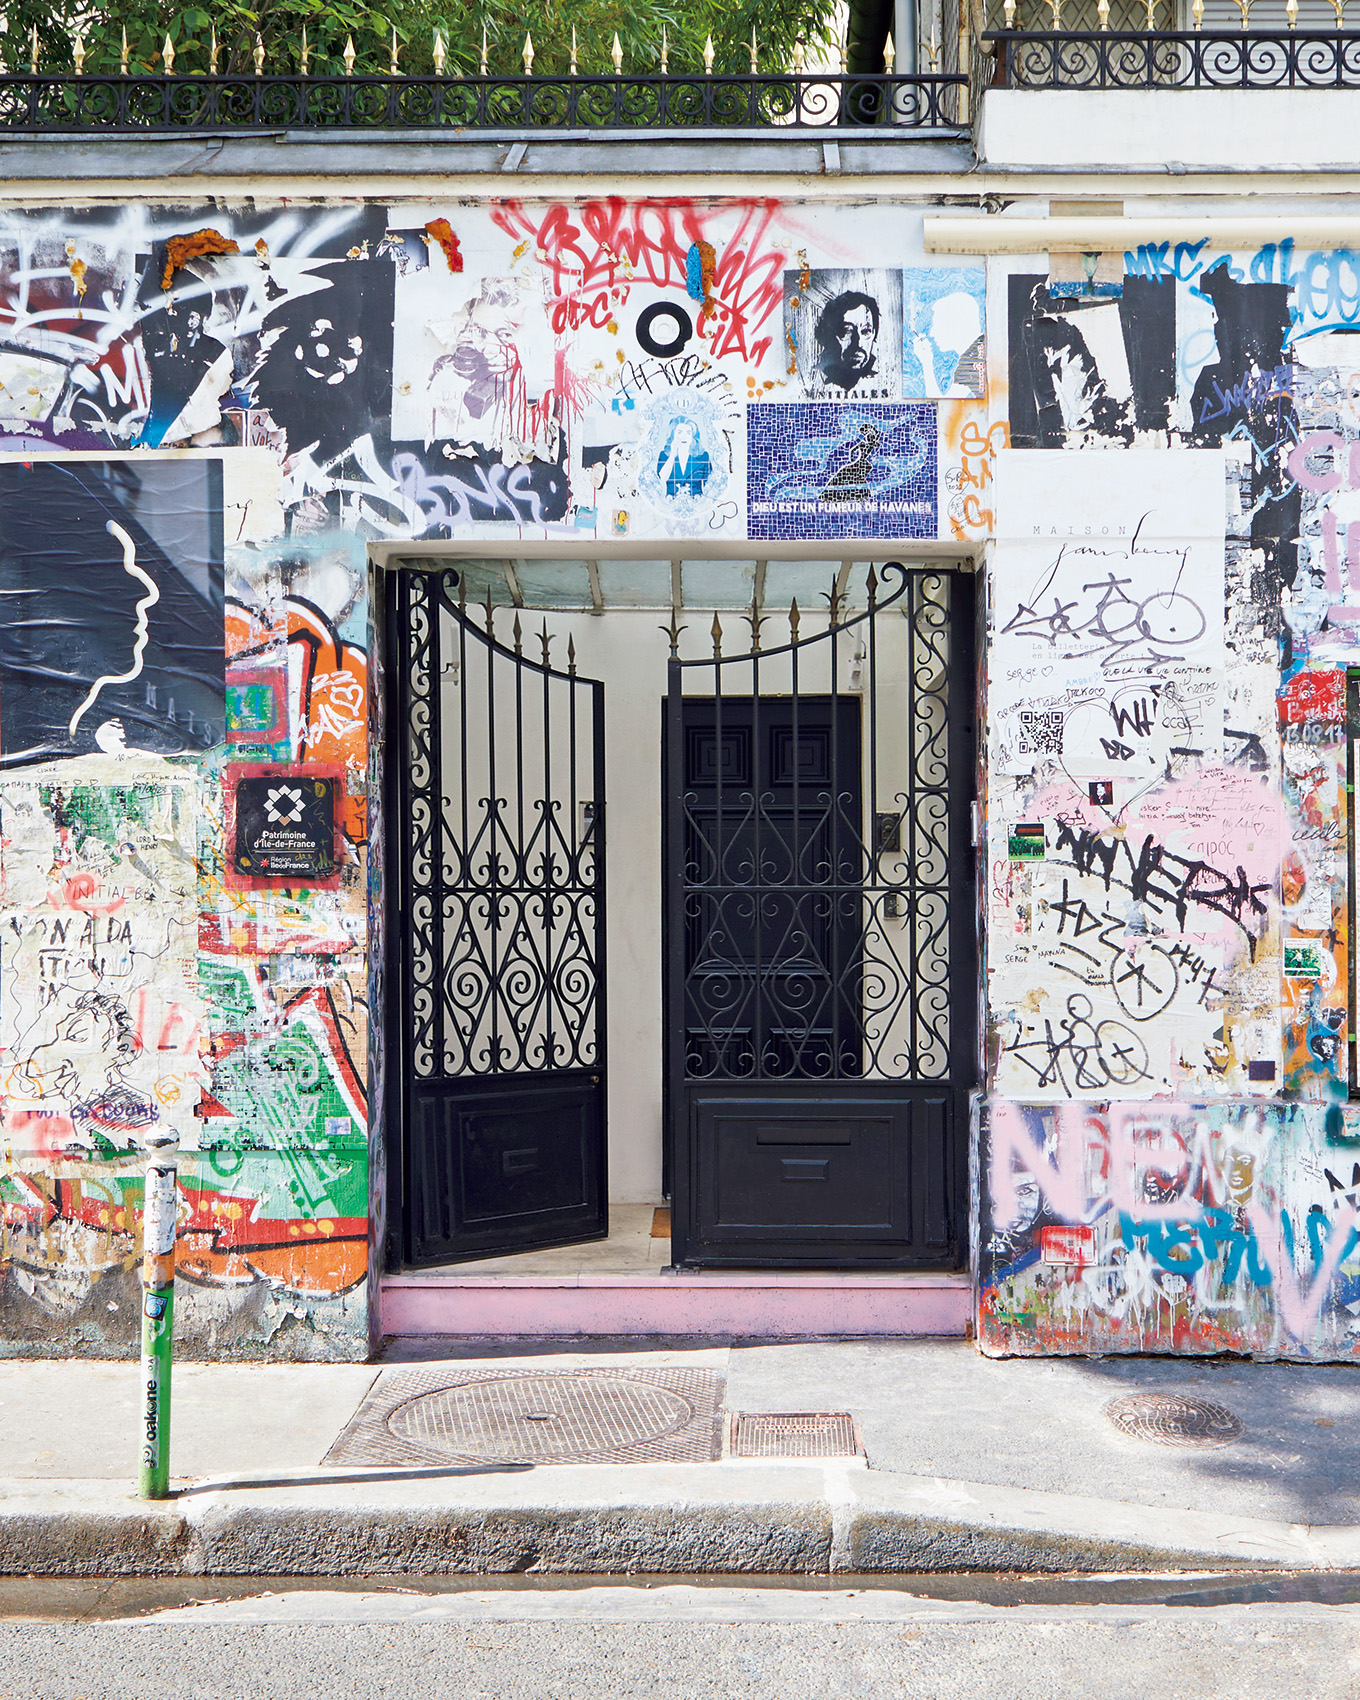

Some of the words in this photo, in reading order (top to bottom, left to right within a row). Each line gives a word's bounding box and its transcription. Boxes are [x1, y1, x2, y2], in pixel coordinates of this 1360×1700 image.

[752, 502, 778, 513] DIEU
[779, 502, 799, 513] EST
[801, 502, 816, 513] UN
[818, 502, 862, 513] FUMEUR
[865, 502, 878, 513] DE
[880, 502, 932, 513] HAVANES
[1033, 526, 1127, 535] MAISON
[262, 830, 307, 839] Patrimoine
[271, 856, 292, 864] Région
[1004, 954, 1029, 964] SERGE
[144, 1380, 158, 1442] oakone
